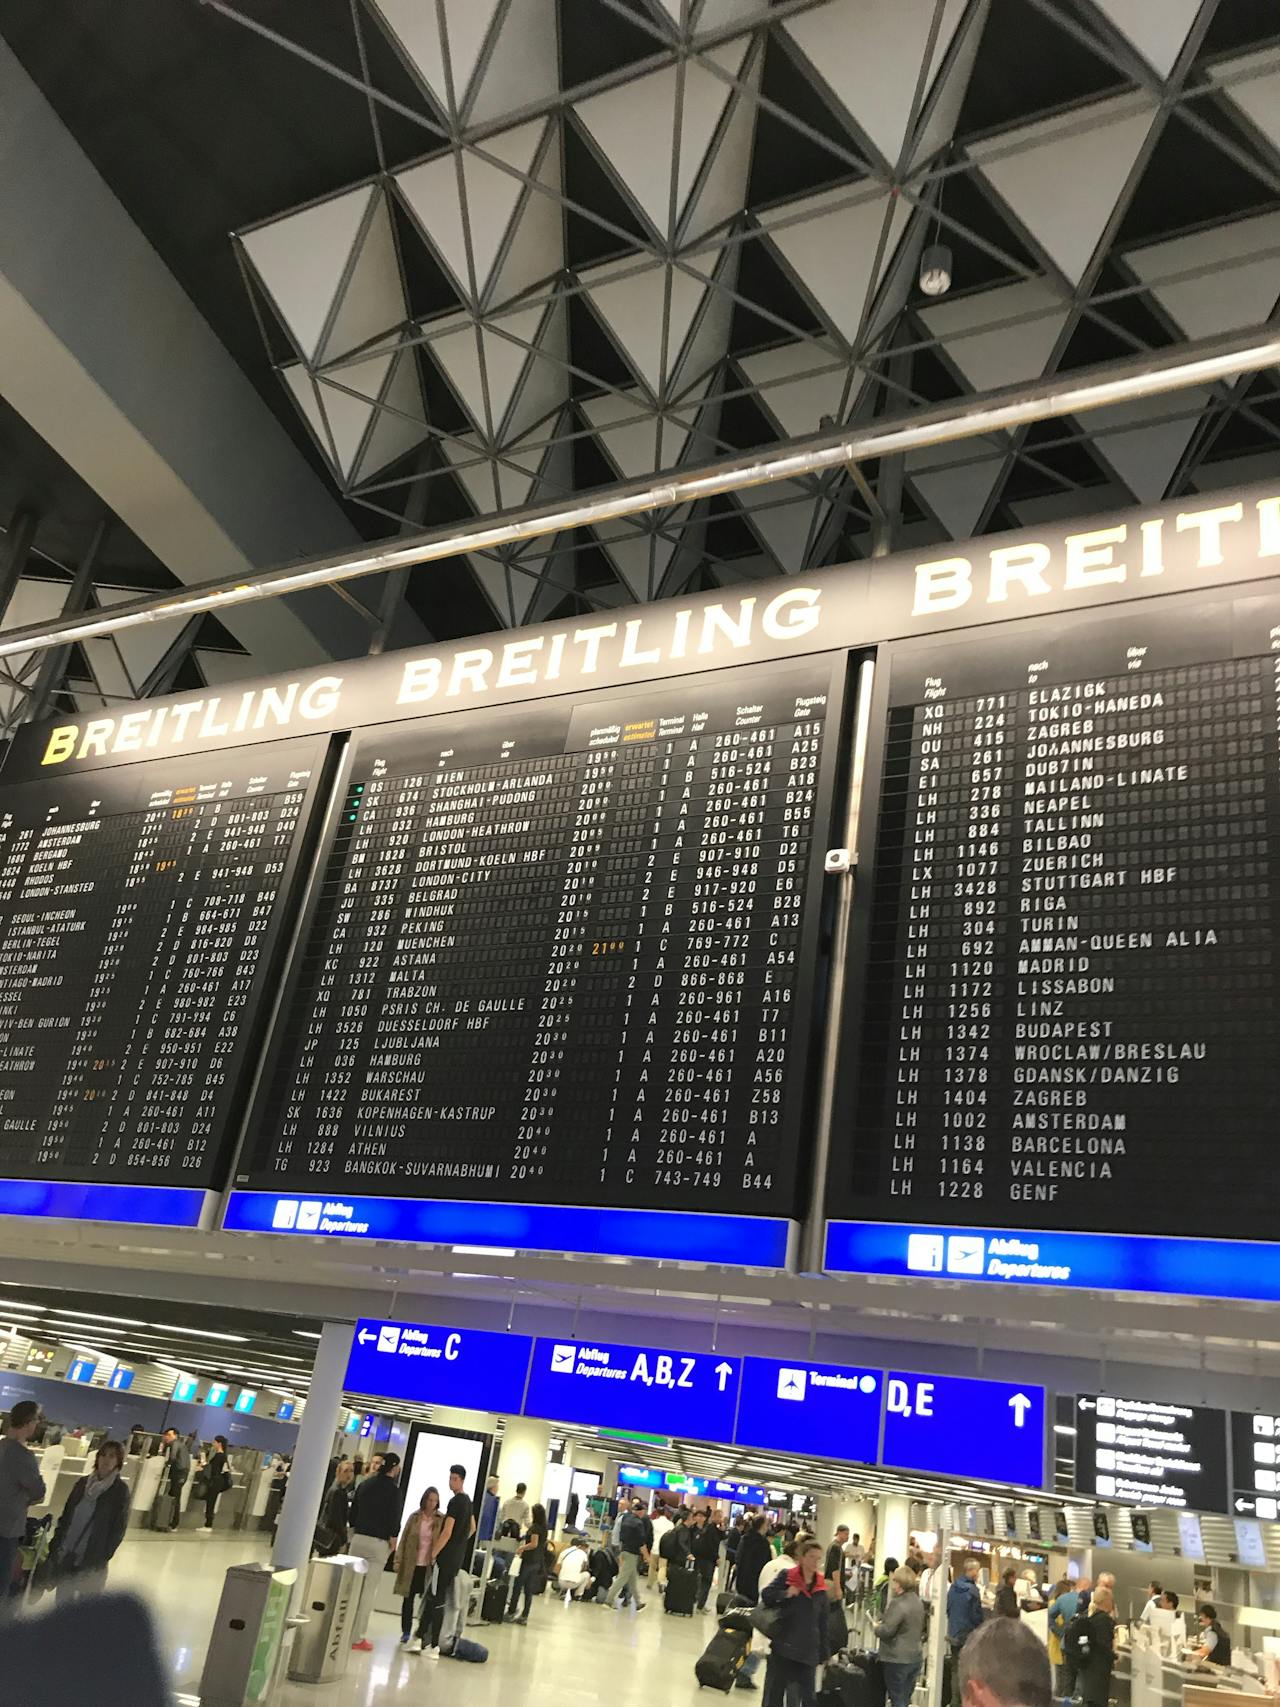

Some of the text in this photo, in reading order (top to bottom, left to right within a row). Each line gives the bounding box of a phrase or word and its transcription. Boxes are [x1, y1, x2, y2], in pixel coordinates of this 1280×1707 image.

[396, 587, 821, 705] BREITLING
[41, 676, 344, 765] BREITLING
[973, 692, 1164, 730] 224 TOKIO-HANEDA
[1026, 719, 1094, 741] ZAGREB
[402, 721, 821, 789] 126 WIEN A15
[972, 748, 1002, 766] 261
[431, 744, 772, 799] STOCKHOLM-ARLANDA 260-461
[970, 765, 1188, 802] 278 MAILAND-LINATE
[394, 789, 536, 818] 936 SHANGHAI-PUDONG
[424, 777, 768, 828] HAMBURG 260-461
[1023, 794, 1091, 815] NEAPEL
[388, 820, 531, 847] 920 LONDON-HEATHROW
[417, 810, 764, 858] BRISTOL 260-461
[967, 812, 1104, 839] 884 TALLINN
[1022, 833, 1092, 853] BILBAO
[373, 848, 546, 877] 3628 DORTMUND-KOELN HBF
[411, 844, 760, 888] LONDON-CITY 907-910
[956, 852, 1103, 877] 1077 ZUERICH
[1021, 866, 1177, 893] STUTTGART HBF
[373, 887, 458, 906] 335 BELGRAD
[404, 879, 756, 919] WINDHUK 917-920
[963, 895, 1067, 916] 892 RIGA
[366, 894, 801, 937] 932 PEKING B28
[1020, 915, 1079, 933] TURIN
[396, 915, 751, 950] MUENCHEN 260-461
[961, 928, 1217, 956] 692 AMMAN-QUEEN ALIA
[358, 952, 436, 969] 922 ASTANA
[388, 952, 746, 982] MALTA 260-461
[1017, 956, 1089, 974] MADRID
[350, 984, 438, 1001] 781 TRABZON
[949, 977, 1114, 998] 1172 LISSABON
[454, 999, 470, 1013] DE
[477, 997, 525, 1012] GAULLE
[678, 989, 742, 1005] 260-961
[1016, 1000, 1064, 1017] LINZ
[334, 1016, 490, 1034] 3526 DUESSELDORF HBF
[947, 1020, 1113, 1040] 1342 BUDAPEST
[373, 1028, 737, 1049] LJUBLJANA 260-461
[333, 1052, 422, 1067] 036 HAMBURG
[1014, 1042, 1206, 1061] WROCLAW/BRESLAU
[365, 1067, 732, 1084] WARSCHAU 260-461
[944, 1065, 1179, 1084] 1378 GDANSK/DANZIG
[319, 1088, 781, 1104] 1422 BUKAREST Z58
[1012, 1089, 1087, 1107] ZAGREB
[356, 1105, 727, 1124] KOPENHAGEN-KASTRUP 260-461
[943, 1111, 1126, 1130] 1002 AMSTERDAM
[316, 1123, 406, 1138] 888 VILNIUS
[347, 1141, 722, 1166] ATHEN 260-461
[1011, 1135, 1126, 1155] BARCELONA
[308, 1158, 500, 1178] 923 BANGKOK-SUVARNABHUMI
[939, 1157, 1112, 1179] 1164 VALENCIA
[1009, 1182, 1058, 1202] GENF
[987, 1258, 1071, 1279] Departures
[398, 1333, 461, 1361] Departures C
[578, 1347, 609, 1364] Abflug
[576, 1352, 696, 1389] Departures A,B,Z
[809, 1371, 934, 1418] Terminal D,E
